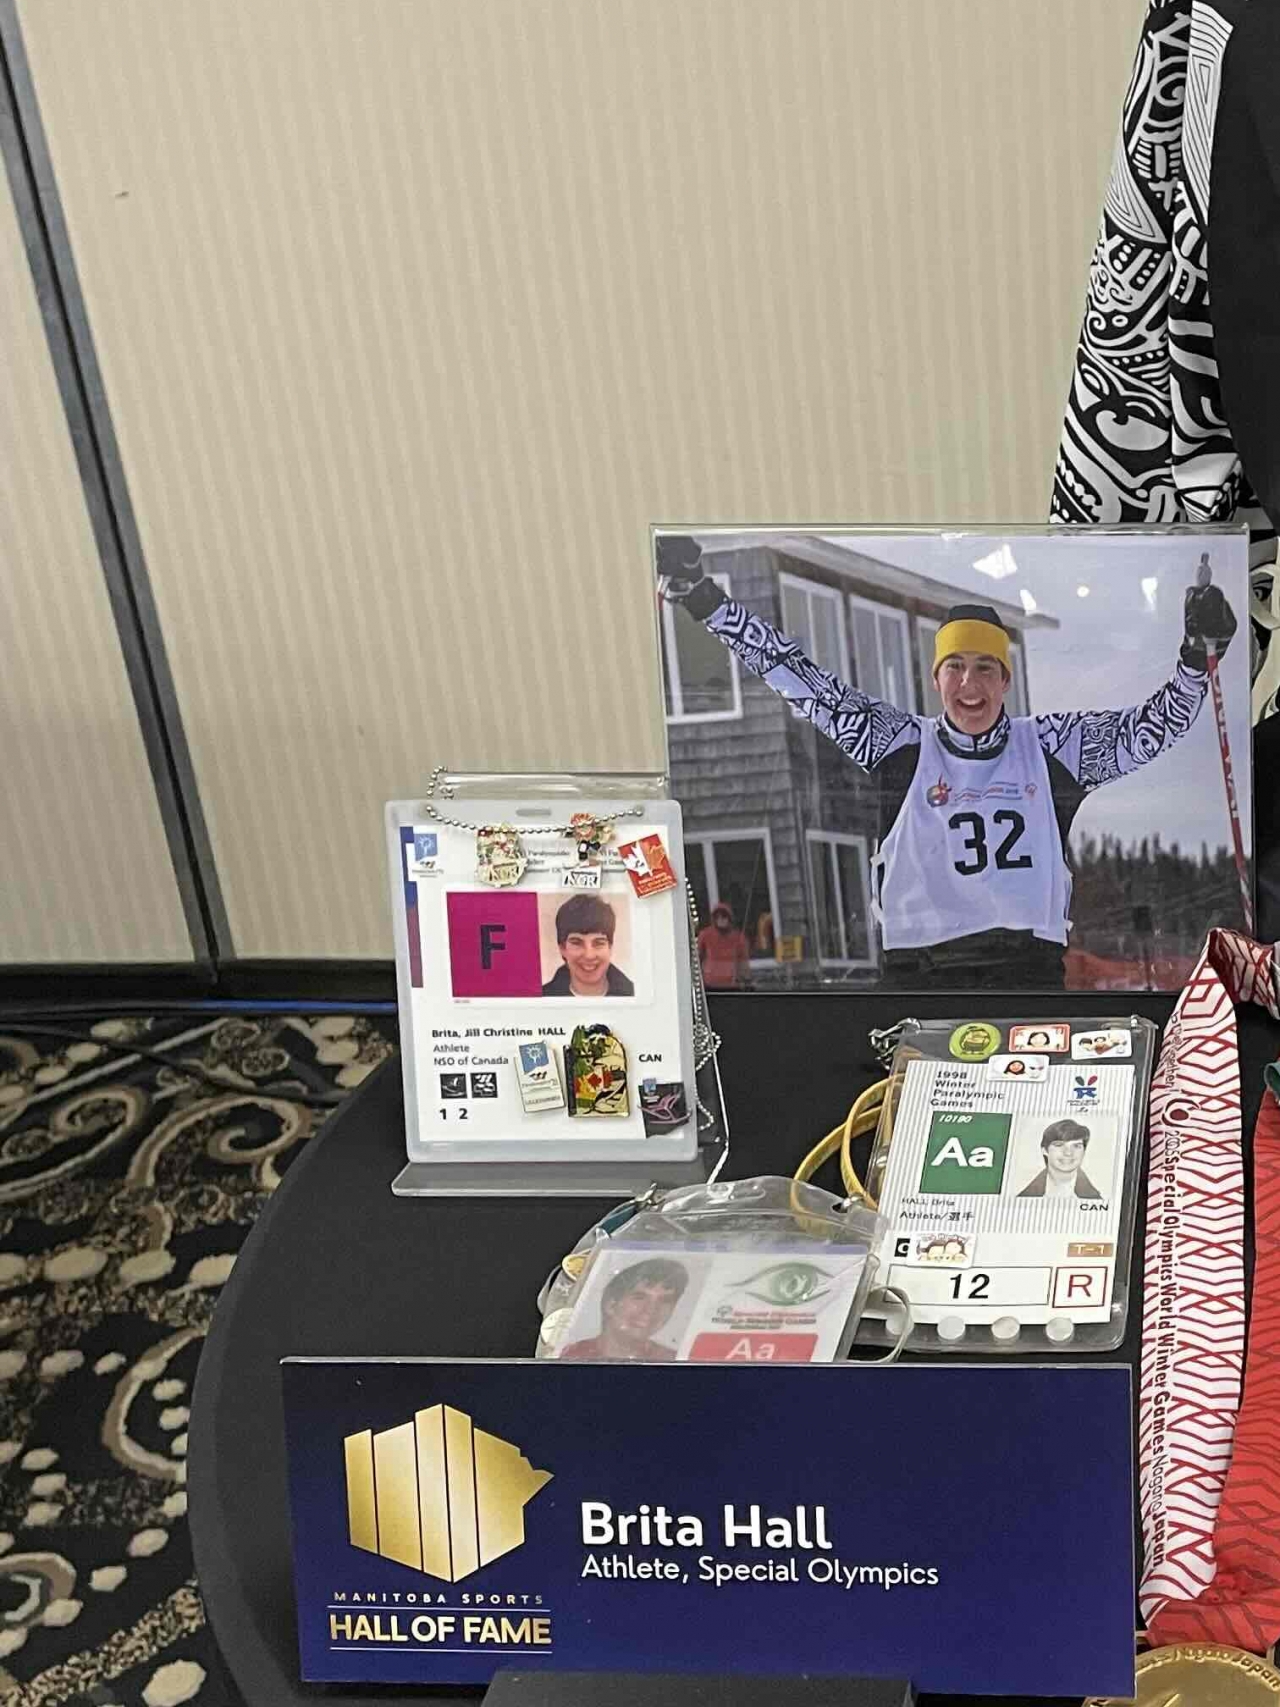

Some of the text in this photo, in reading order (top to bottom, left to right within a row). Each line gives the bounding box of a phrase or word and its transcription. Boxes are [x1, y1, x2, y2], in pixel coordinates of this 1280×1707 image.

[948, 809, 1033, 876] 32
[479, 924, 507, 970] F
[432, 1027, 567, 1038] Brita, Jill Christine HALL
[433, 1044, 470, 1053] Athlete
[433, 1056, 509, 1066] NSO of Canada
[639, 1054, 662, 1062] CAN
[935, 1080, 976, 1088] Winter
[937, 1071, 967, 1079] 1998
[930, 1098, 973, 1108] Games
[933, 1089, 1006, 1099] Paralympic
[931, 1137, 994, 1167] Aa
[1079, 1203, 1109, 1211] CAN
[1156, 1215, 1182, 1282] Olympics
[950, 1273, 990, 1299] 12
[1067, 1274, 1093, 1298] R
[1158, 1282, 1179, 1331] World
[724, 1337, 775, 1360] Aa
[1154, 1333, 1175, 1388] Winter
[1150, 1391, 1171, 1454] Games
[1148, 1454, 1167, 1512] Nagano
[582, 1501, 833, 1550] Brita Hall
[1150, 1511, 1168, 1567] Japan
[581, 1554, 939, 1590] Athlete, Special Olympics
[334, 1591, 544, 1605] MANITOBA SPORTS
[329, 1613, 552, 1645] HALL OF FAME
